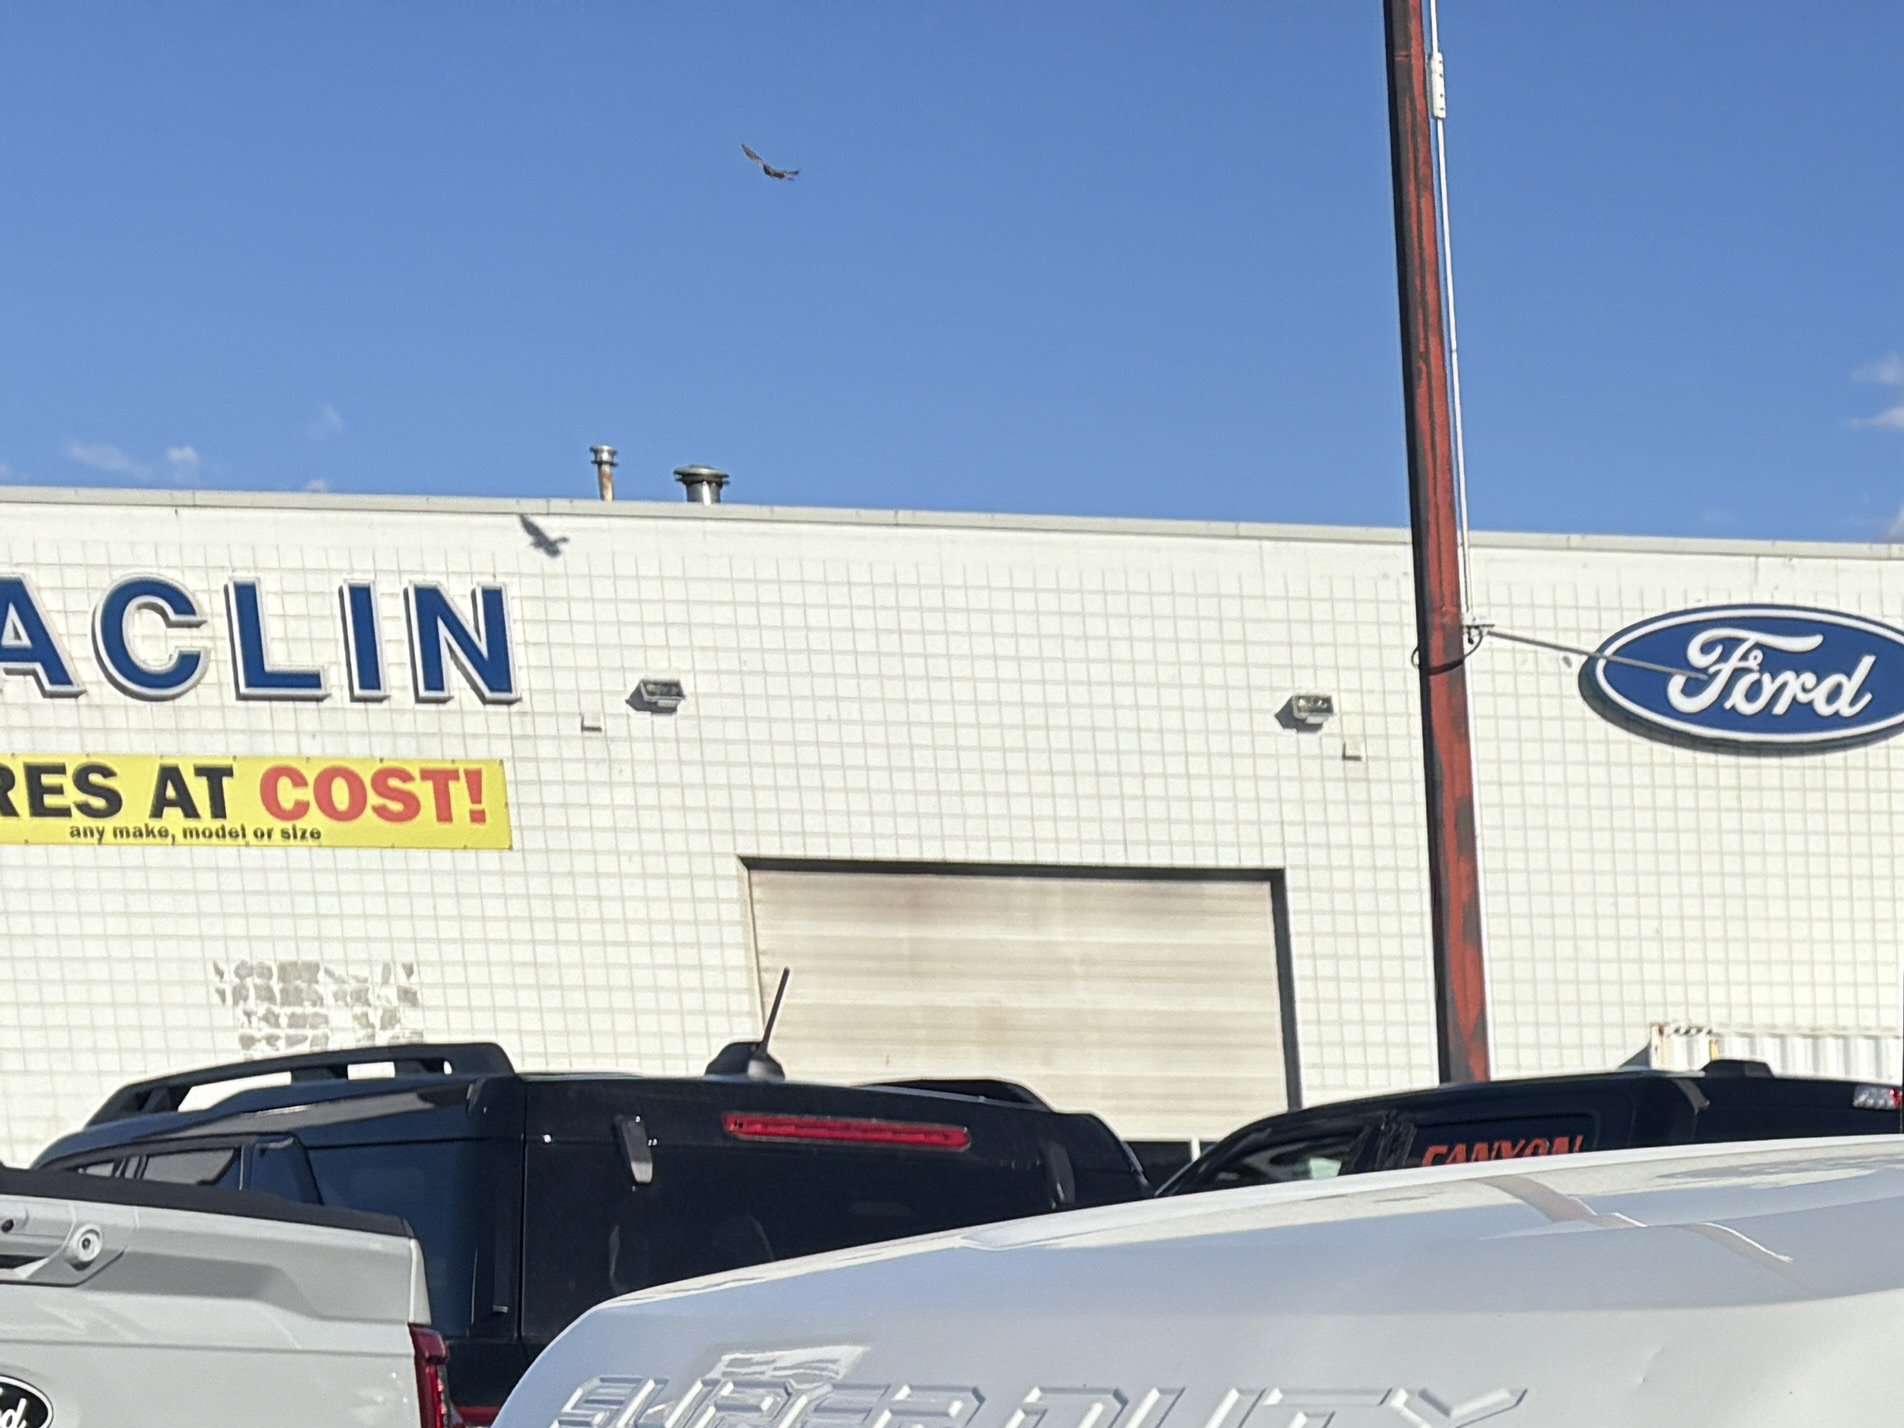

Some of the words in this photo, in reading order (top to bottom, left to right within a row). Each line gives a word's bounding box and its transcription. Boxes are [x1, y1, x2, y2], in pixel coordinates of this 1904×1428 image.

[1667, 627, 1876, 718] Ford
[148, 763, 235, 820] AT
[258, 764, 488, 824] COST!
[69, 825, 105, 844] any
[112, 823, 175, 845] make,
[182, 823, 246, 841] model
[253, 826, 275, 841] or
[281, 823, 322, 842] size
